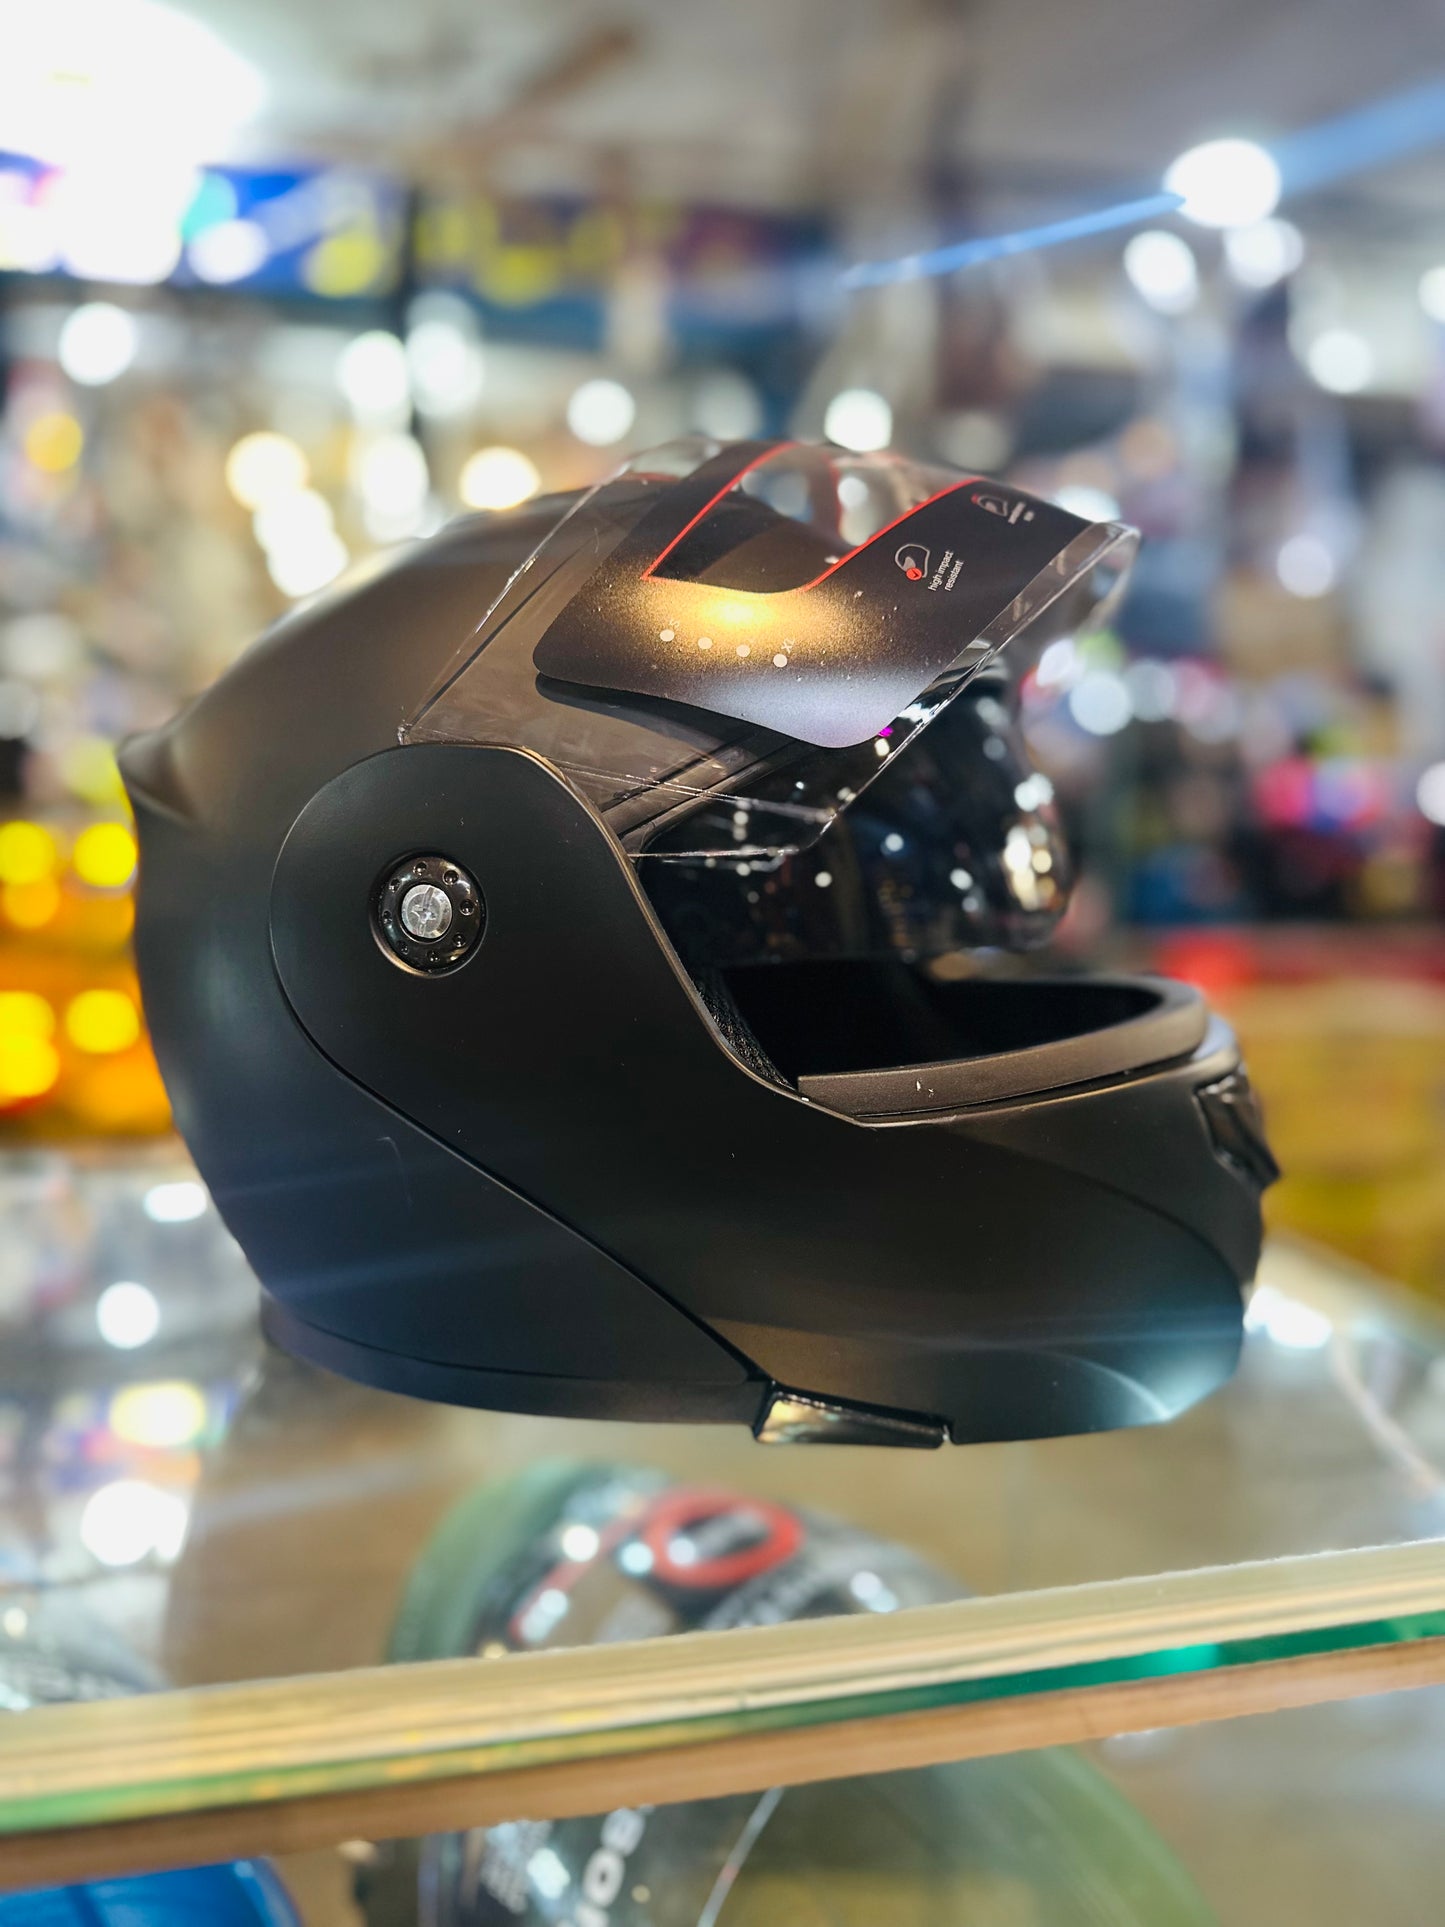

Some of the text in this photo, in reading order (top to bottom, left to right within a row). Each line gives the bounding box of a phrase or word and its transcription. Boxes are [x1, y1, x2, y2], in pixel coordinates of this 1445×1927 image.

[928, 551, 954, 591] high impact
[944, 560, 964, 591] resistant
